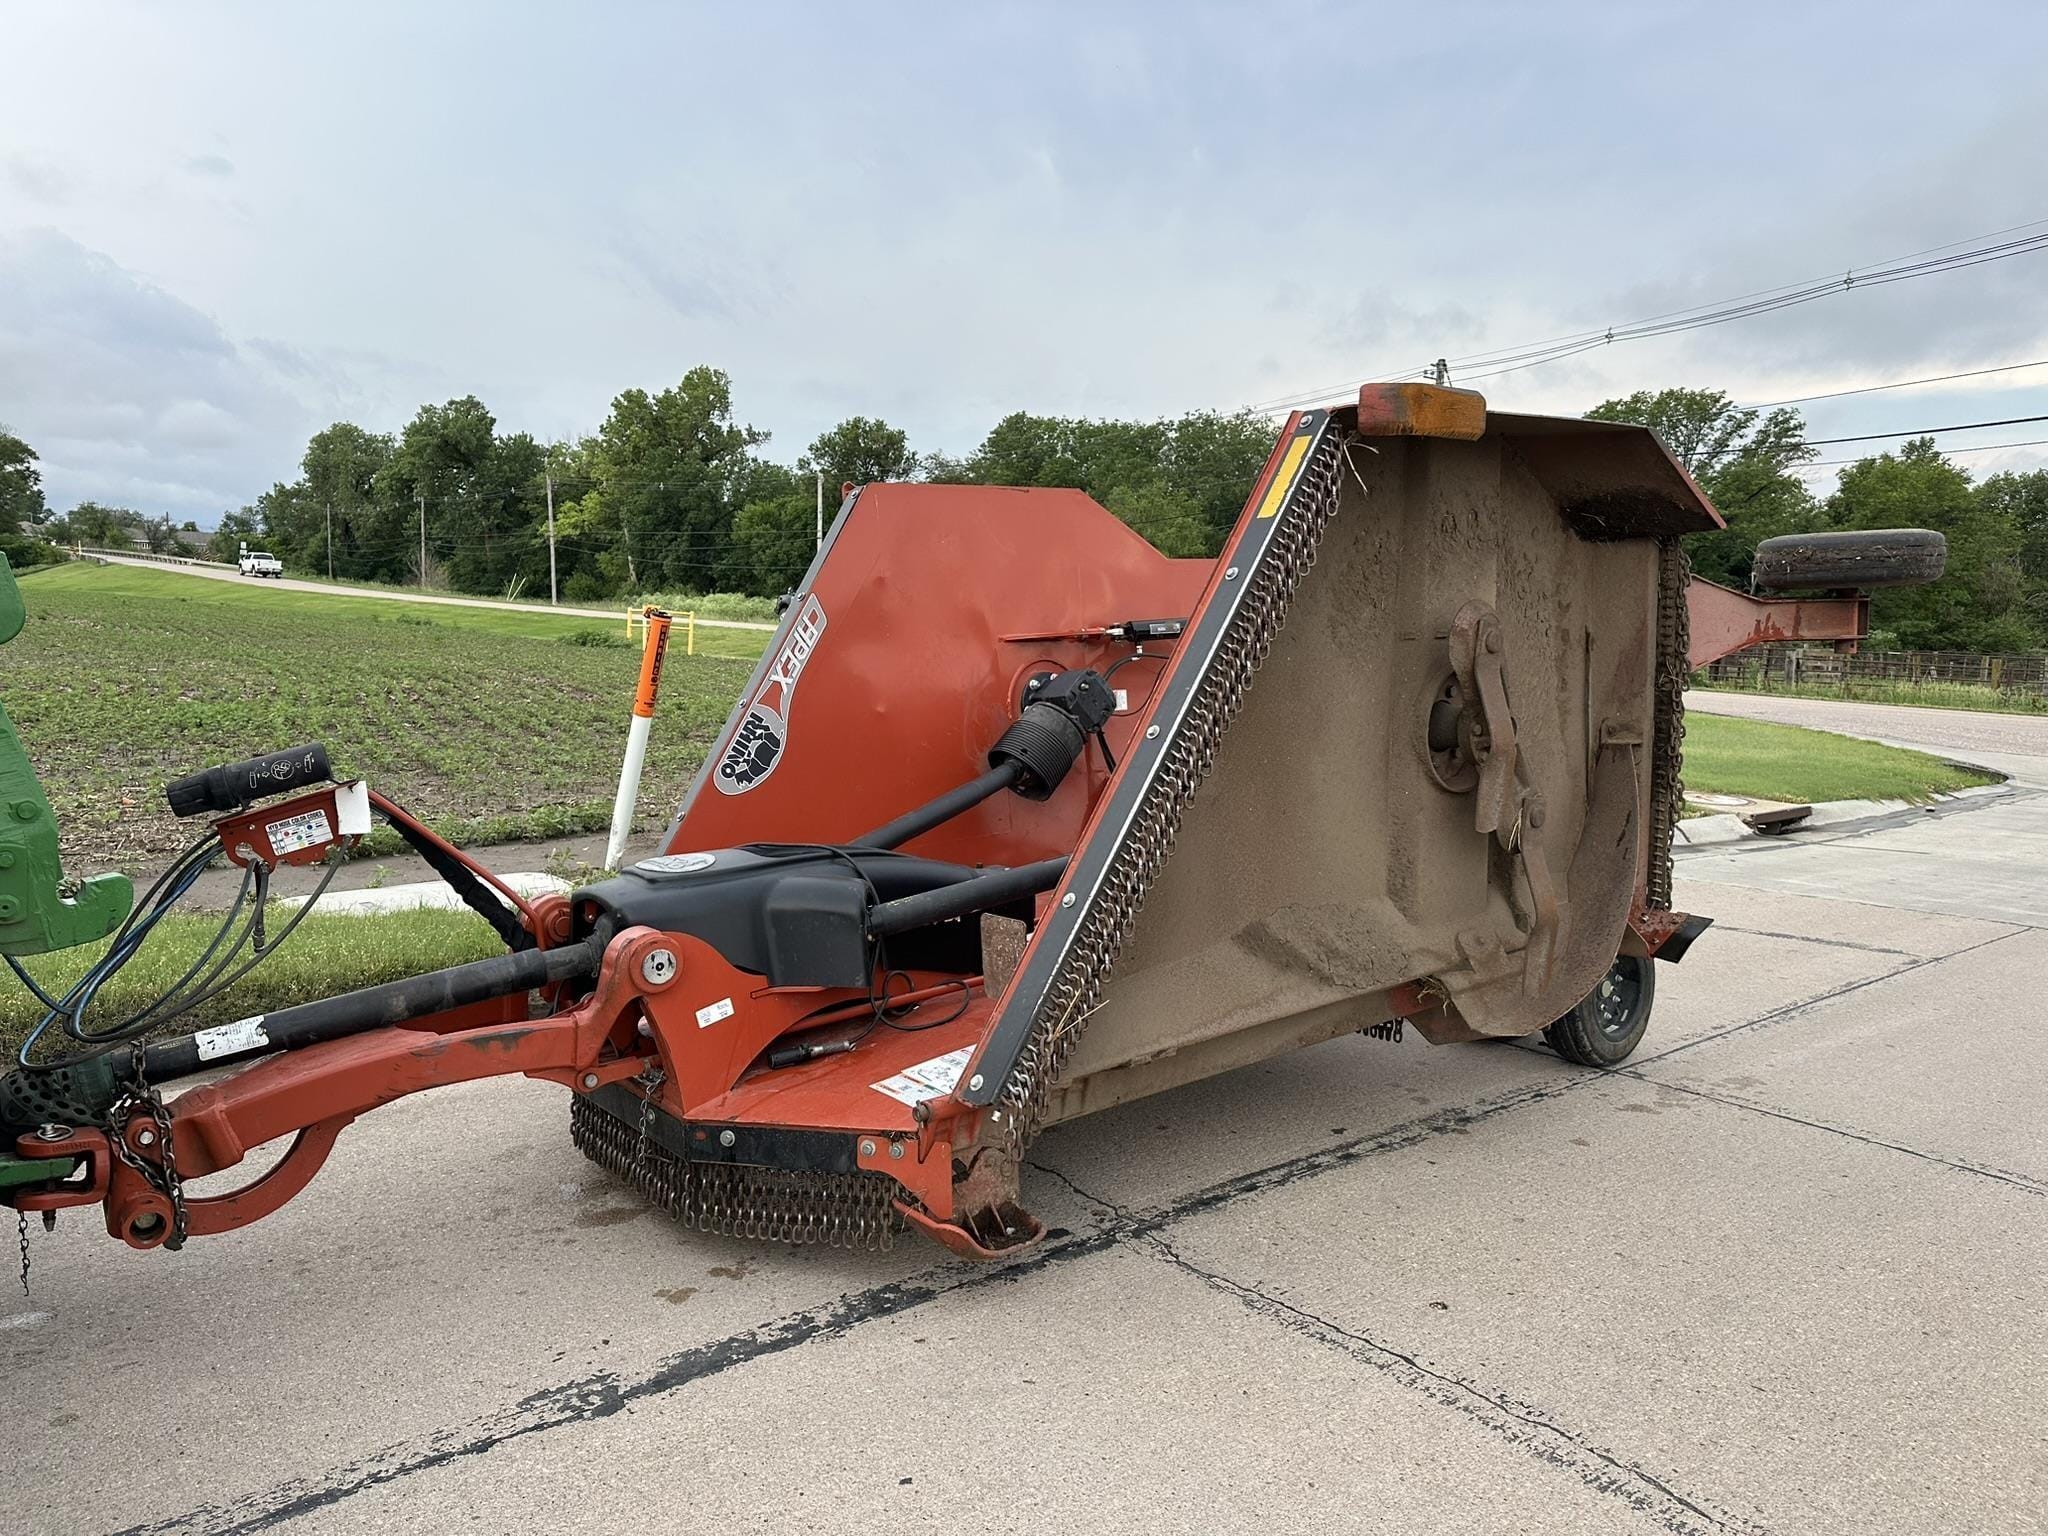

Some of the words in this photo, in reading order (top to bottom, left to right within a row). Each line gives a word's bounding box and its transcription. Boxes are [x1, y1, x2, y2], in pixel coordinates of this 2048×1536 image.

[769, 615, 819, 695] APEX
[720, 712, 765, 779] RHINO
[291, 815, 307, 824] COLOR
[307, 811, 323, 820] CODES
